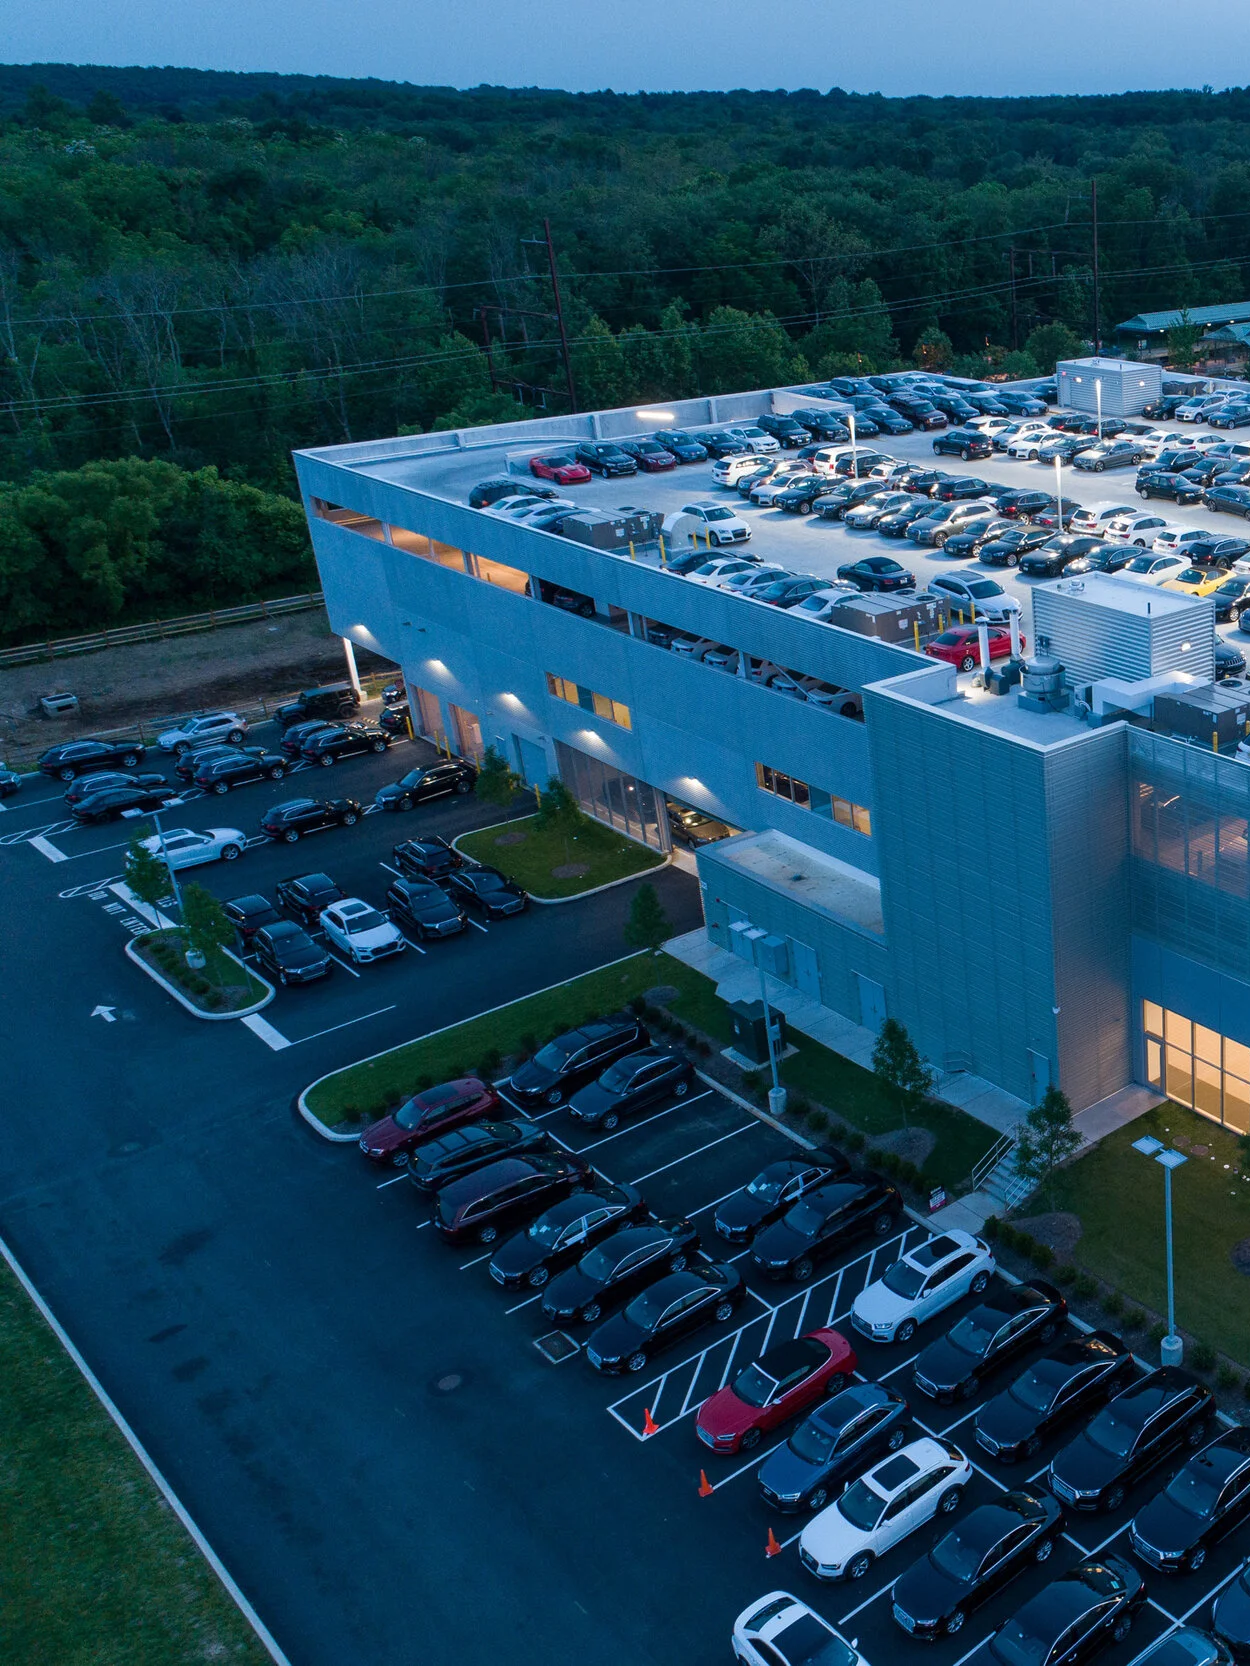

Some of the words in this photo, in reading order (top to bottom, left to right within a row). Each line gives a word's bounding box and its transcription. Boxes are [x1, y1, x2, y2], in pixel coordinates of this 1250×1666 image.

[88, 891, 109, 901] DO
[101, 901, 127, 915] NOT
[119, 916, 152, 936] ENTER
